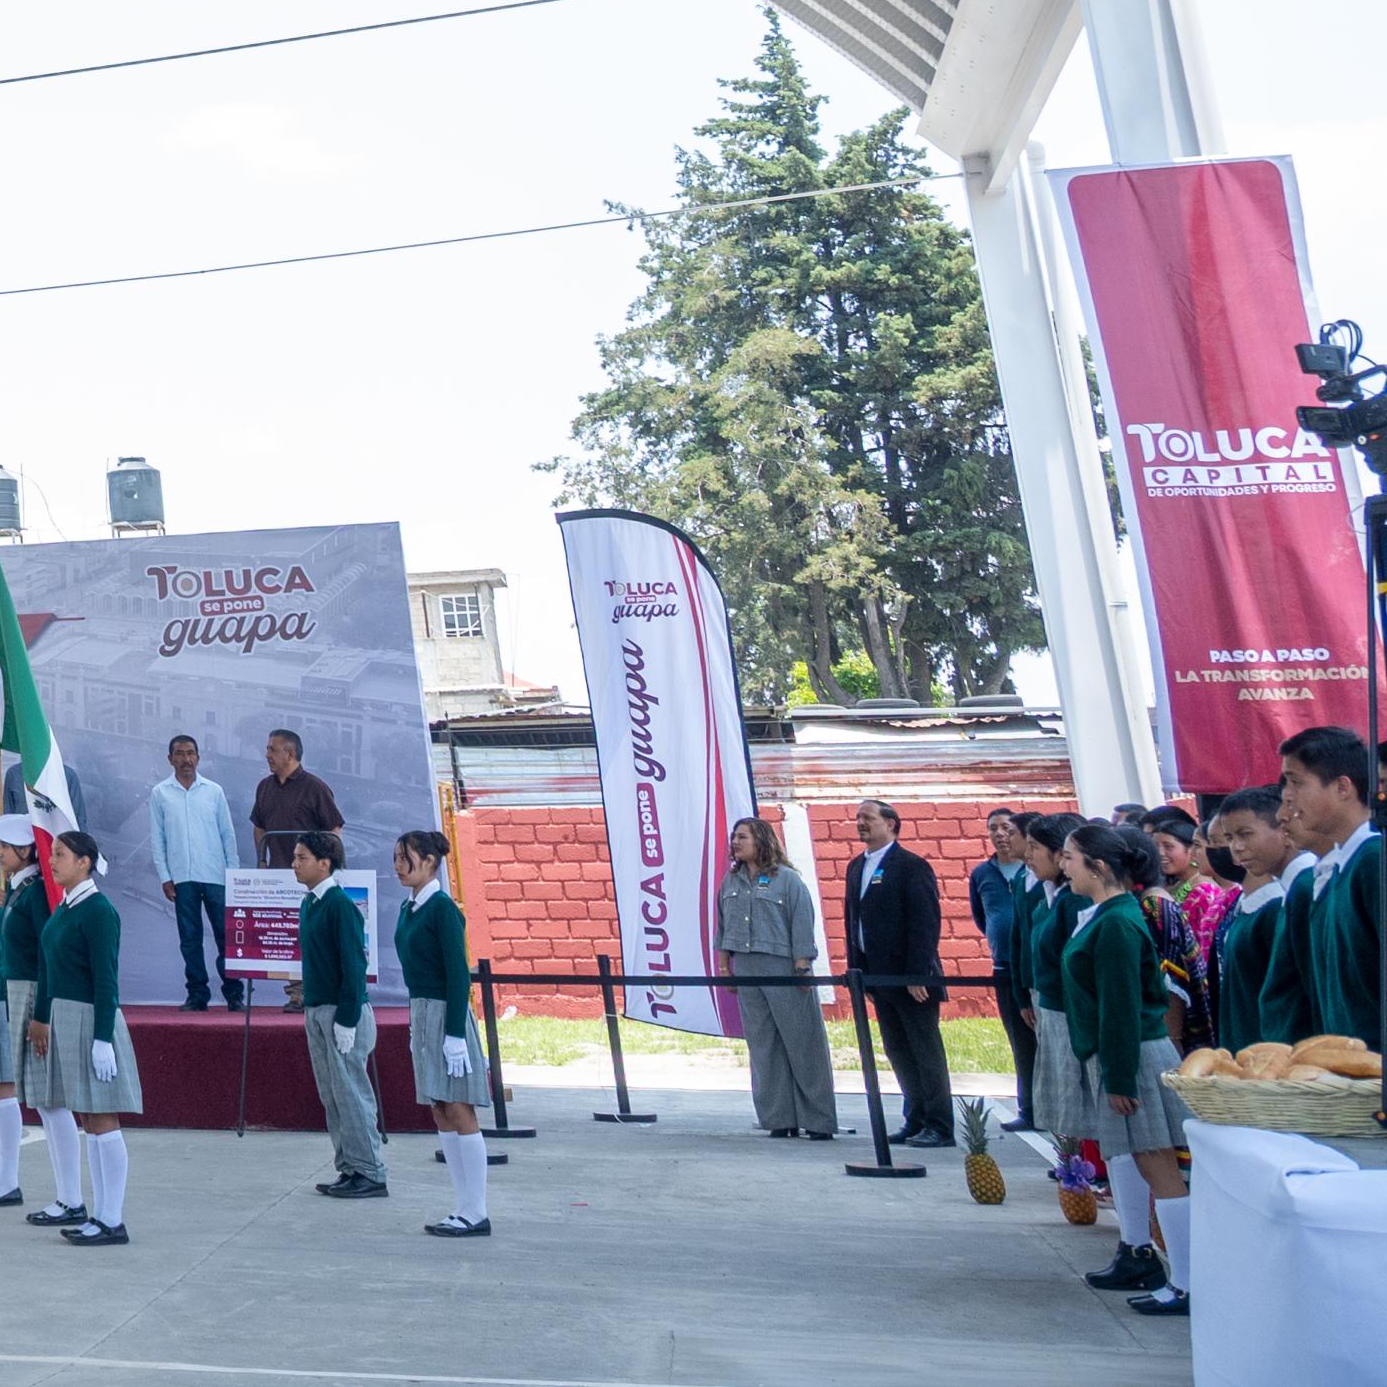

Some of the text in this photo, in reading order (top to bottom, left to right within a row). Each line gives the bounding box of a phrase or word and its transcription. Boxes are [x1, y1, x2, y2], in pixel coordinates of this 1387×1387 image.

[1127, 423, 1331, 463] TOLUCA
[1151, 465, 1327, 485] CAPITAL
[1147, 483, 1337, 497] DE OPORTUNIDADES Y PROGRESO
[147, 565, 315, 600] TOLUCA
[603, 580, 678, 597] TOLUCA
[203, 599, 263, 614] se pone
[612, 603, 680, 624] guapa
[159, 612, 316, 657] guapa
[1209, 648, 1330, 663] PASO A PASO
[1175, 670, 1200, 683] LA
[1237, 687, 1315, 701] AVANZA
[621, 638, 678, 1019] TOLUCA se pone guapa
